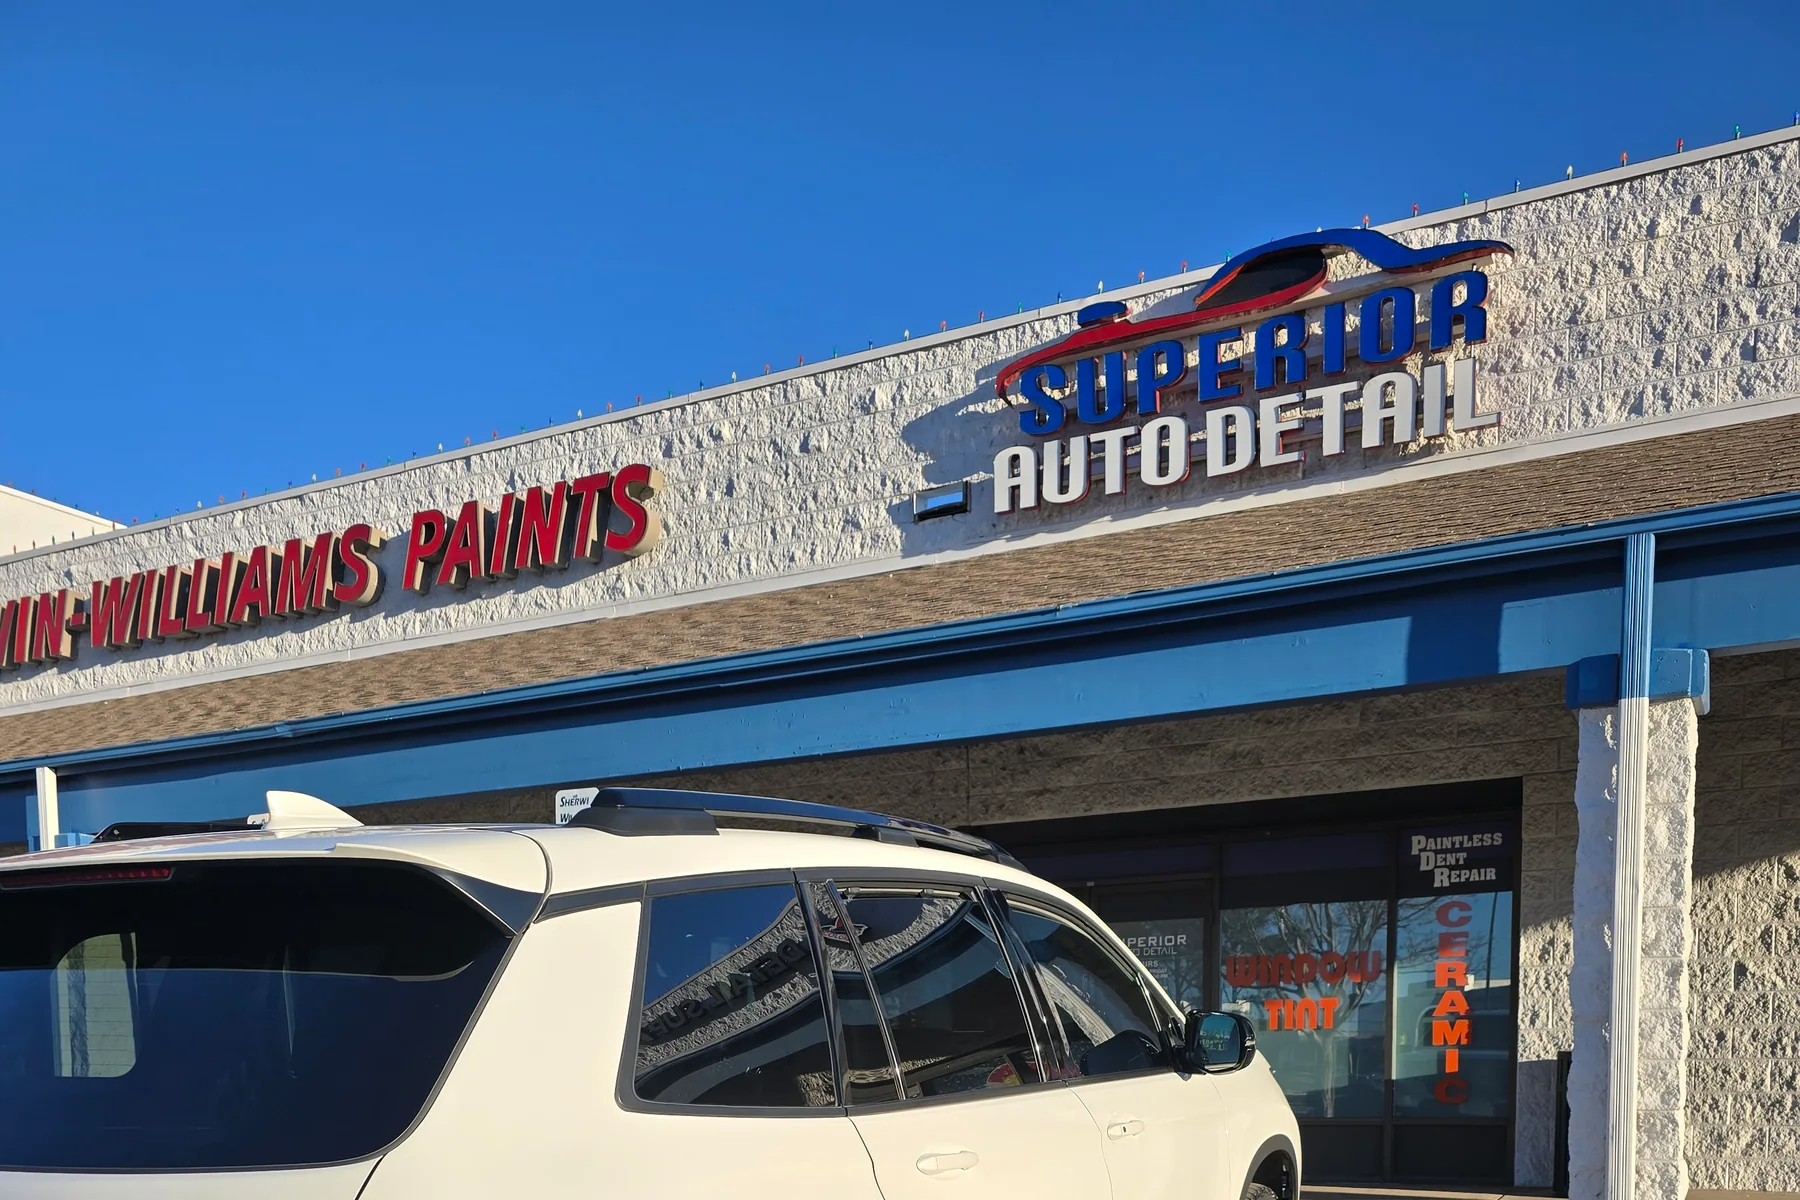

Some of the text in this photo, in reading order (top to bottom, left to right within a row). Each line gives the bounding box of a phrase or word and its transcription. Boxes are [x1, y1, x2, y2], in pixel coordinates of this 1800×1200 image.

[1018, 270, 1488, 436] SUPERIOR
[993, 357, 1500, 516] AUTO DETAIL
[401, 462, 664, 595] PAINTS
[1411, 832, 1503, 856] PAINTLESS
[1419, 851, 1467, 872] DENT
[1433, 867, 1497, 888] REPAIR
[1122, 934, 1187, 948] PERIOR
[1143, 946, 1178, 957] DETAIL
[1226, 950, 1382, 989] WINDOW
[1264, 997, 1339, 1031] TINT
[1432, 900, 1473, 1105] CERAMIC
